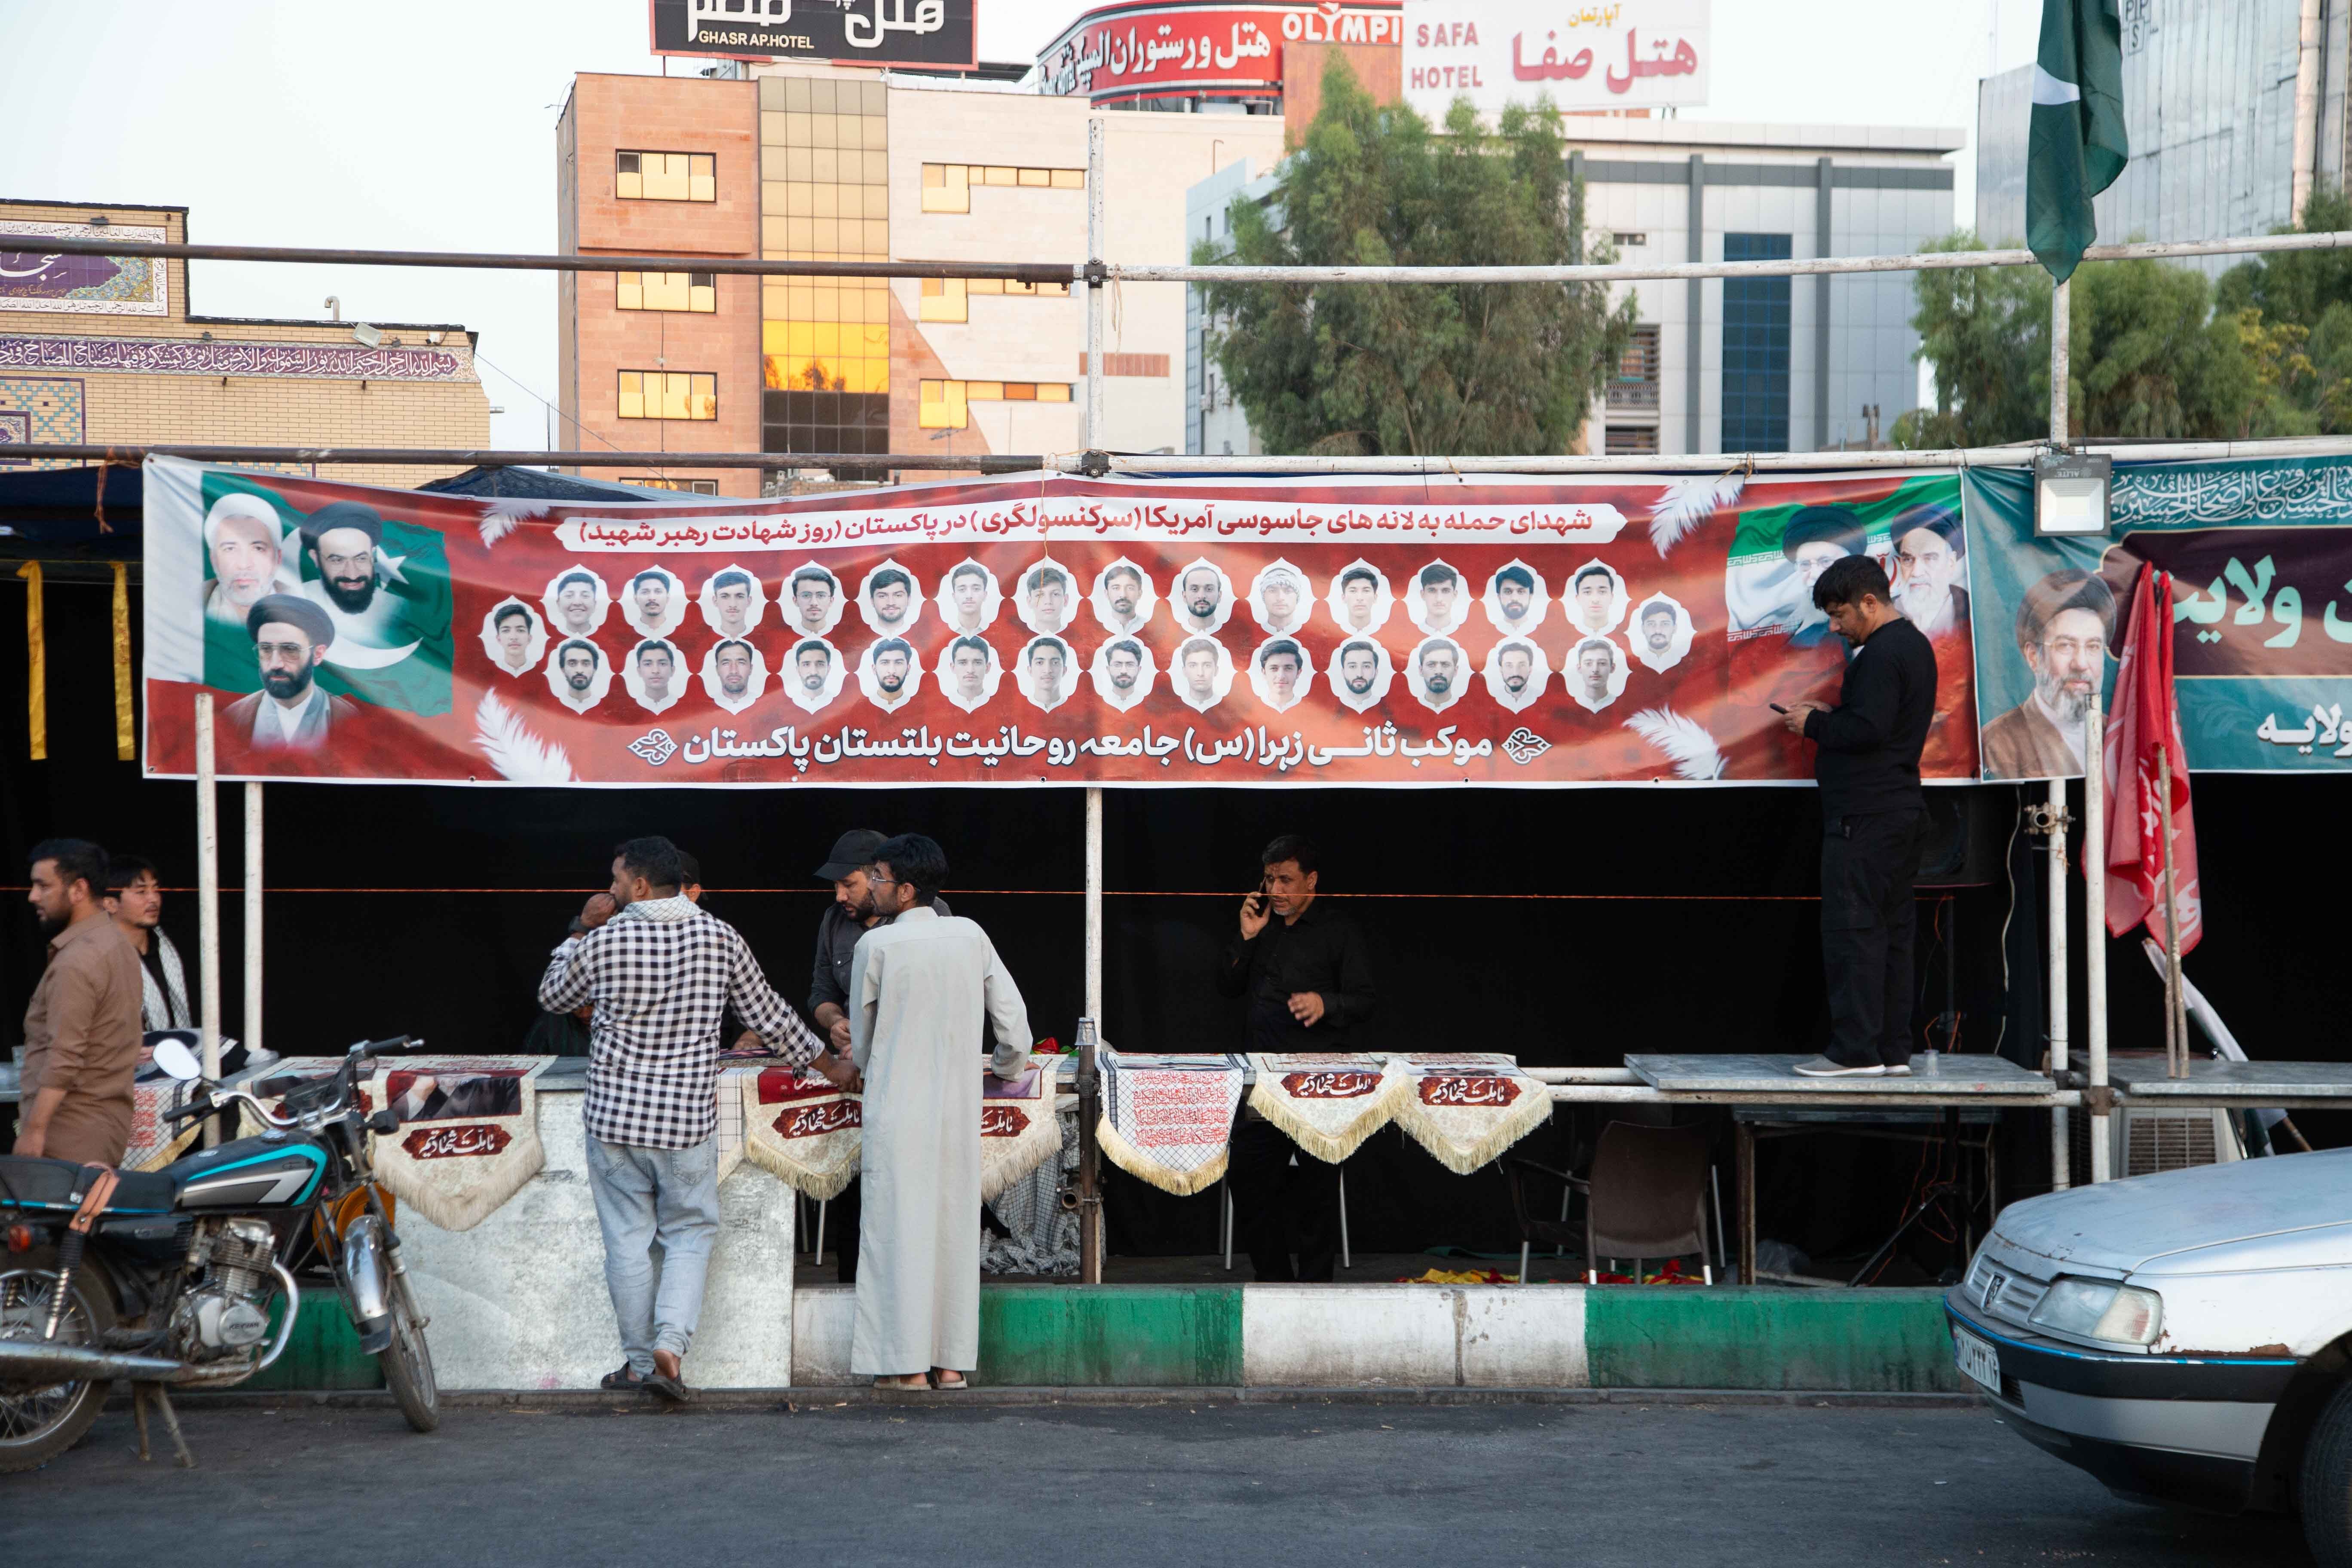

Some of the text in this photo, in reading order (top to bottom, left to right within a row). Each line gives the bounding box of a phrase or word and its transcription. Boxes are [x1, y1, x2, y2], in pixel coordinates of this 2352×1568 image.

[1282, 5, 1400, 42] OLYMPI
[1568, 3, 1621, 28] آپارتمان
[698, 30, 748, 46] GHASR
[1110, 24, 1194, 74] رستوران
[1215, 21, 1271, 69] هتل
[1417, 21, 1479, 47] SAFA
[1196, 35, 1212, 69] و
[1512, 27, 1698, 94] هتل صفا
[1412, 65, 1483, 89] HOTEL
[656, 524, 708, 546] رهبر
[712, 519, 797, 545] شهادت
[845, 513, 938, 541] پاکستان
[937, 509, 968, 536] در
[1145, 503, 1215, 536] آمریکا
[1217, 508, 1323, 538] جاسوسی
[1418, 513, 1439, 539] به
[1444, 511, 1506, 532] حمله
[1509, 508, 1593, 538] شهدای
[683, 725, 810, 772] پاکستان
[813, 725, 943, 768] بلتستان
[945, 725, 1077, 768] روحانیت
[1080, 723, 1181, 767] جامعه
[1307, 720, 1396, 766] ثانی
[1400, 725, 1493, 768] موکب
